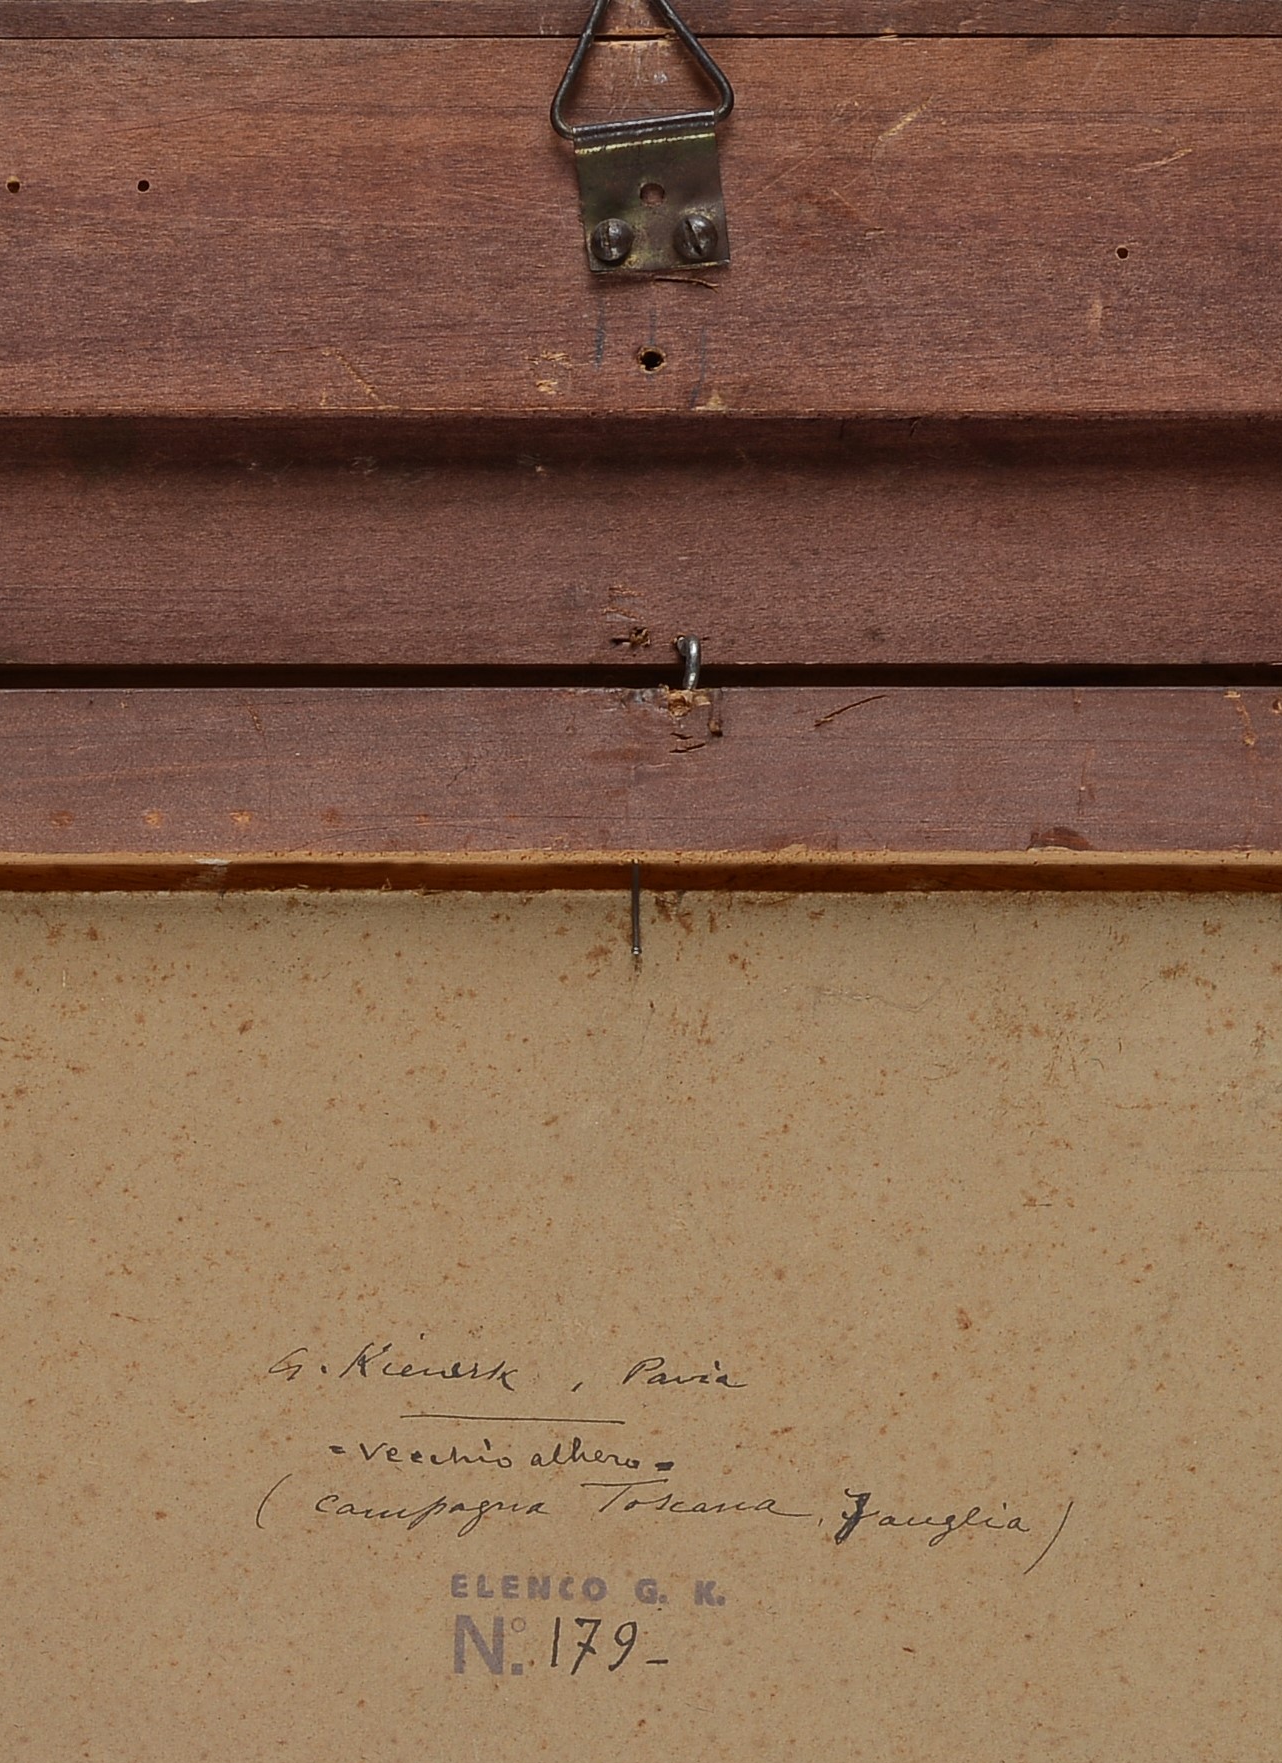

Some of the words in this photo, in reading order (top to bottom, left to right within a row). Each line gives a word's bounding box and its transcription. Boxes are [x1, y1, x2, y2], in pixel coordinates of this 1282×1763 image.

[622, 1357, 748, 1388] Pavia
[450, 1573, 608, 1601] ELENCO
[634, 1577, 668, 1605] G.
[693, 1580, 726, 1607] K.
